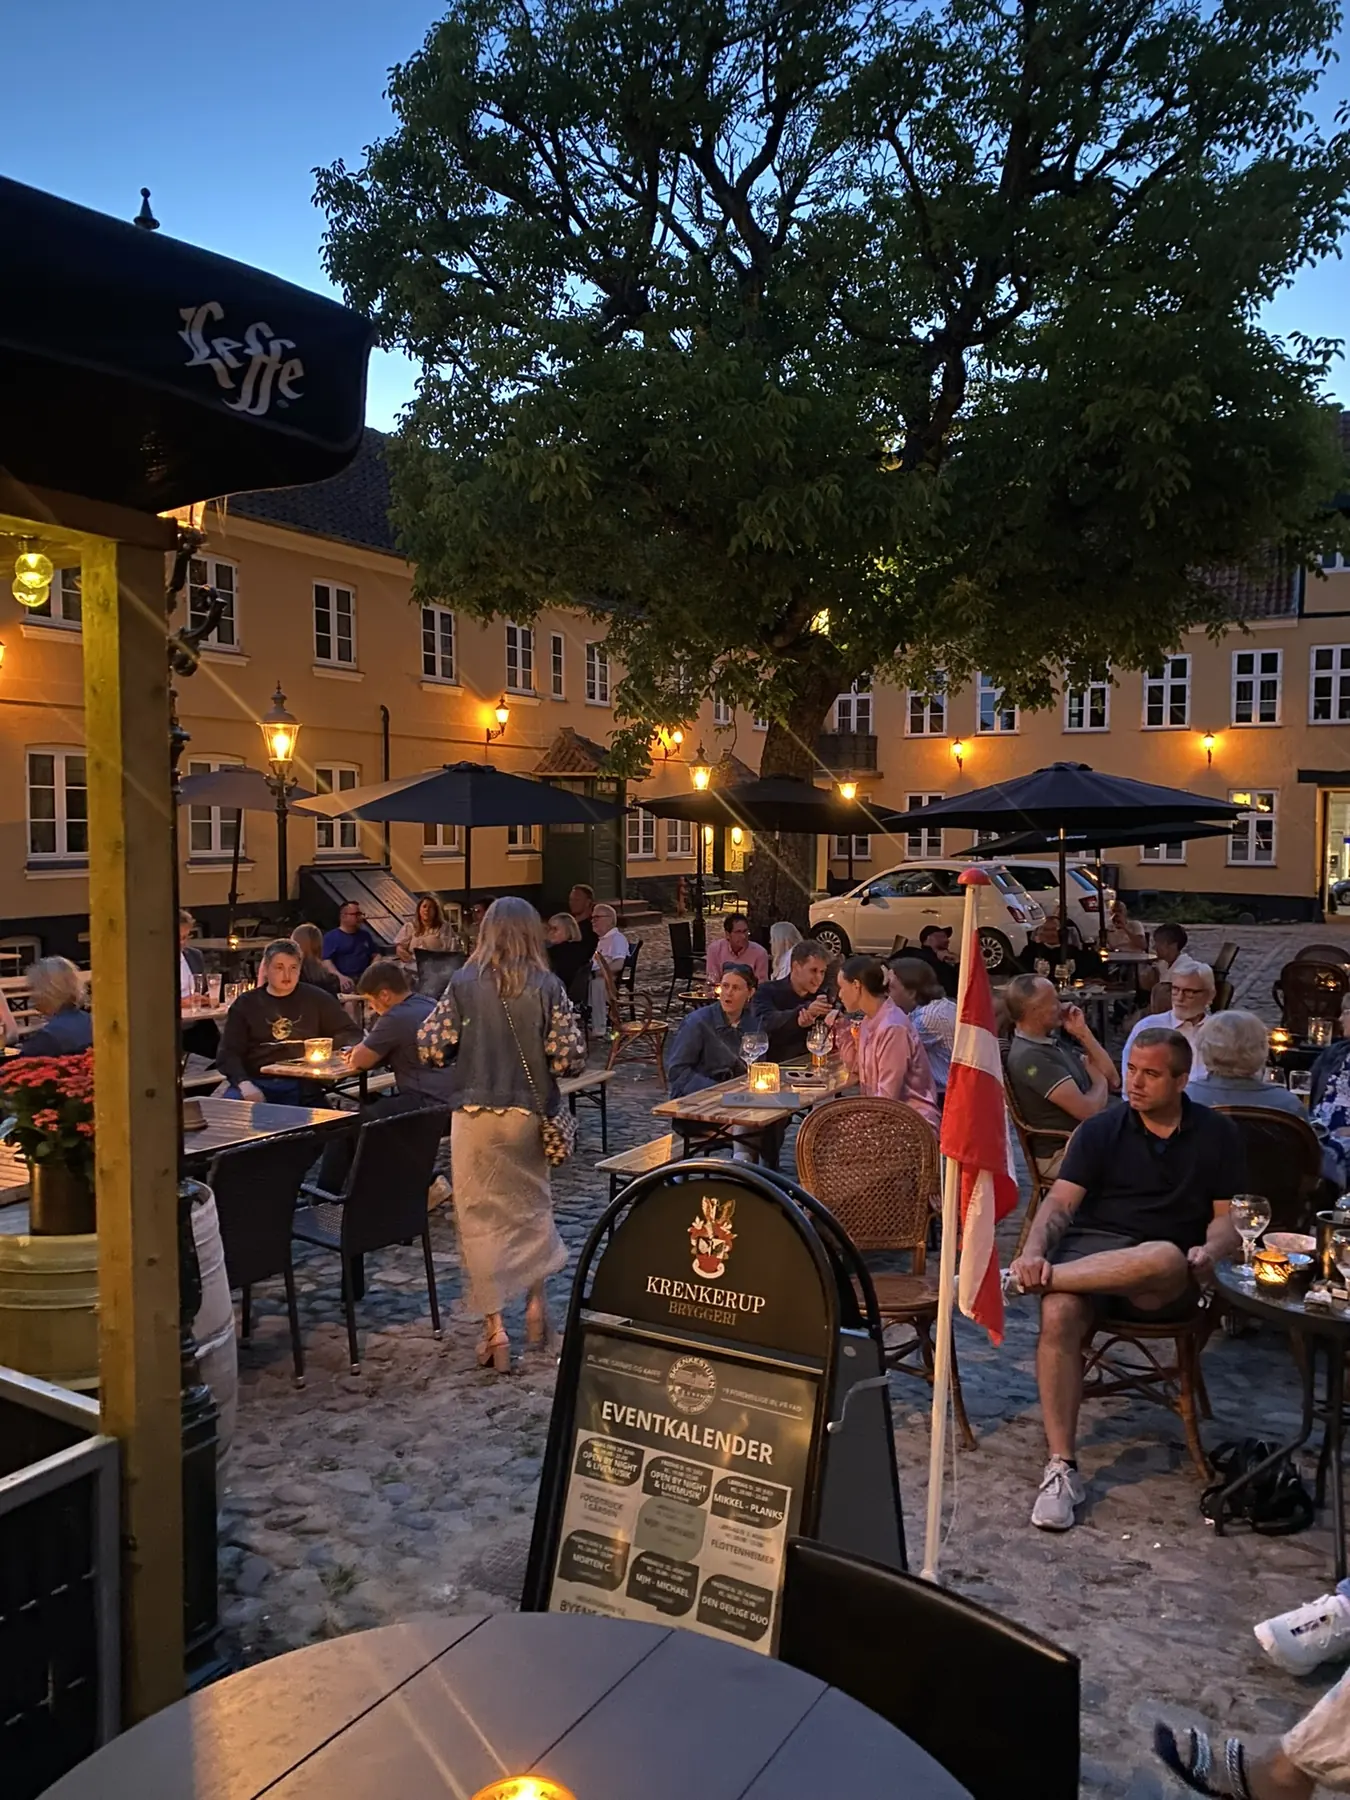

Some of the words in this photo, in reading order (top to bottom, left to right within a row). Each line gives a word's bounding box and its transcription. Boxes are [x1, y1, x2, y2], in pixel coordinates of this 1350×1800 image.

[178, 301, 304, 415] Leffe
[645, 1276, 766, 1314] KRENKERUP
[668, 1301, 737, 1327] BRYGGERI
[602, 1400, 774, 1466] EVENTKALENDER
[582, 1451, 602, 1463] OPEN
[603, 1456, 614, 1465] BY
[614, 1459, 638, 1473] NIGHT
[593, 1462, 631, 1479] LIVEMUSIK
[650, 1470, 670, 1482] OPEN
[671, 1475, 683, 1484] BY
[683, 1478, 708, 1493] NIGHT
[654, 1480, 661, 1488] &
[661, 1481, 702, 1500] LIVEMUSIK
[713, 1493, 744, 1509] MIKKEL
[750, 1504, 784, 1520] PLANKS
[572, 1553, 603, 1571] MORTEN
[711, 1539, 776, 1565] FLOTTENHEIMER
[656, 1580, 690, 1598] MICHAEL
[701, 1595, 718, 1608] DEN
[719, 1600, 749, 1619] DEJLIGE
[749, 1611, 769, 1626] DUO
